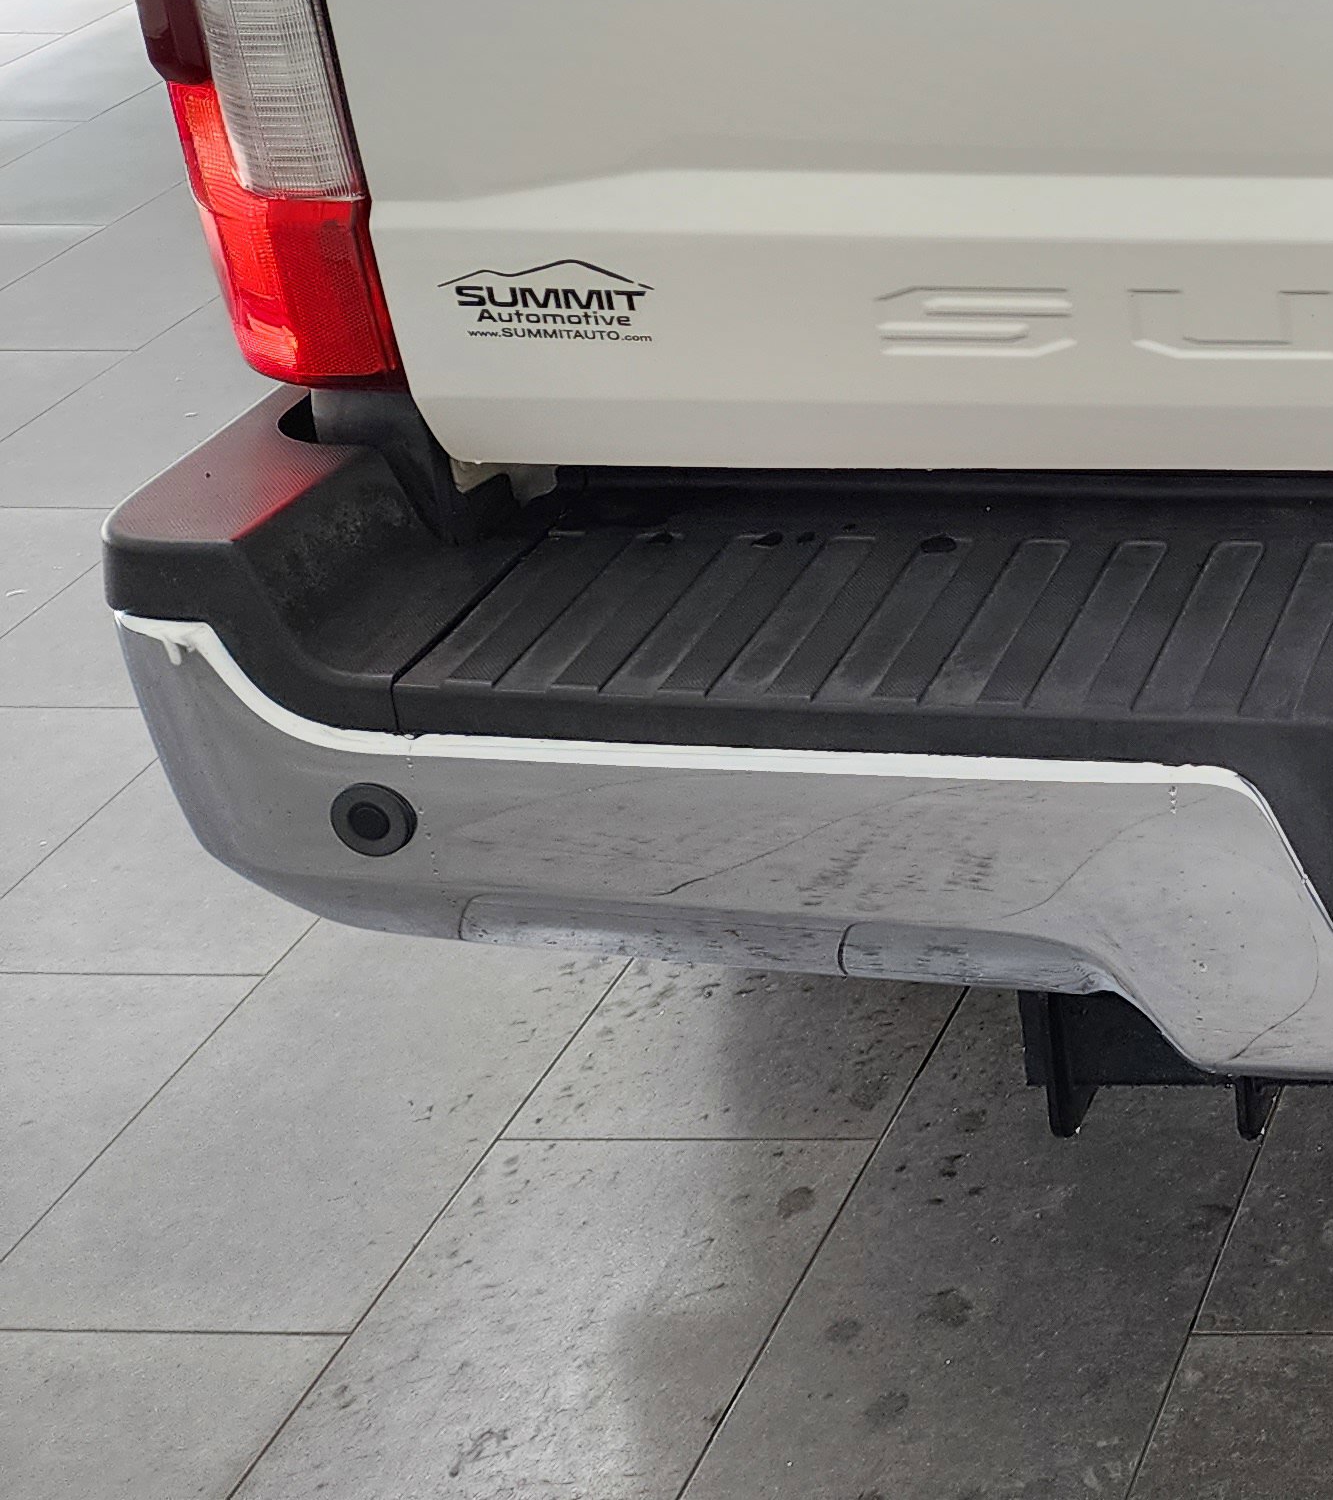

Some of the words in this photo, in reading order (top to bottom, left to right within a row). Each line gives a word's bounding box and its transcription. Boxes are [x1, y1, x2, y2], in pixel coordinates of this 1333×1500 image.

[455, 285, 646, 311] SUMMIT
[477, 308, 631, 327] Automotive
[467, 327, 653, 343] www.SUMMITAUTO.com
